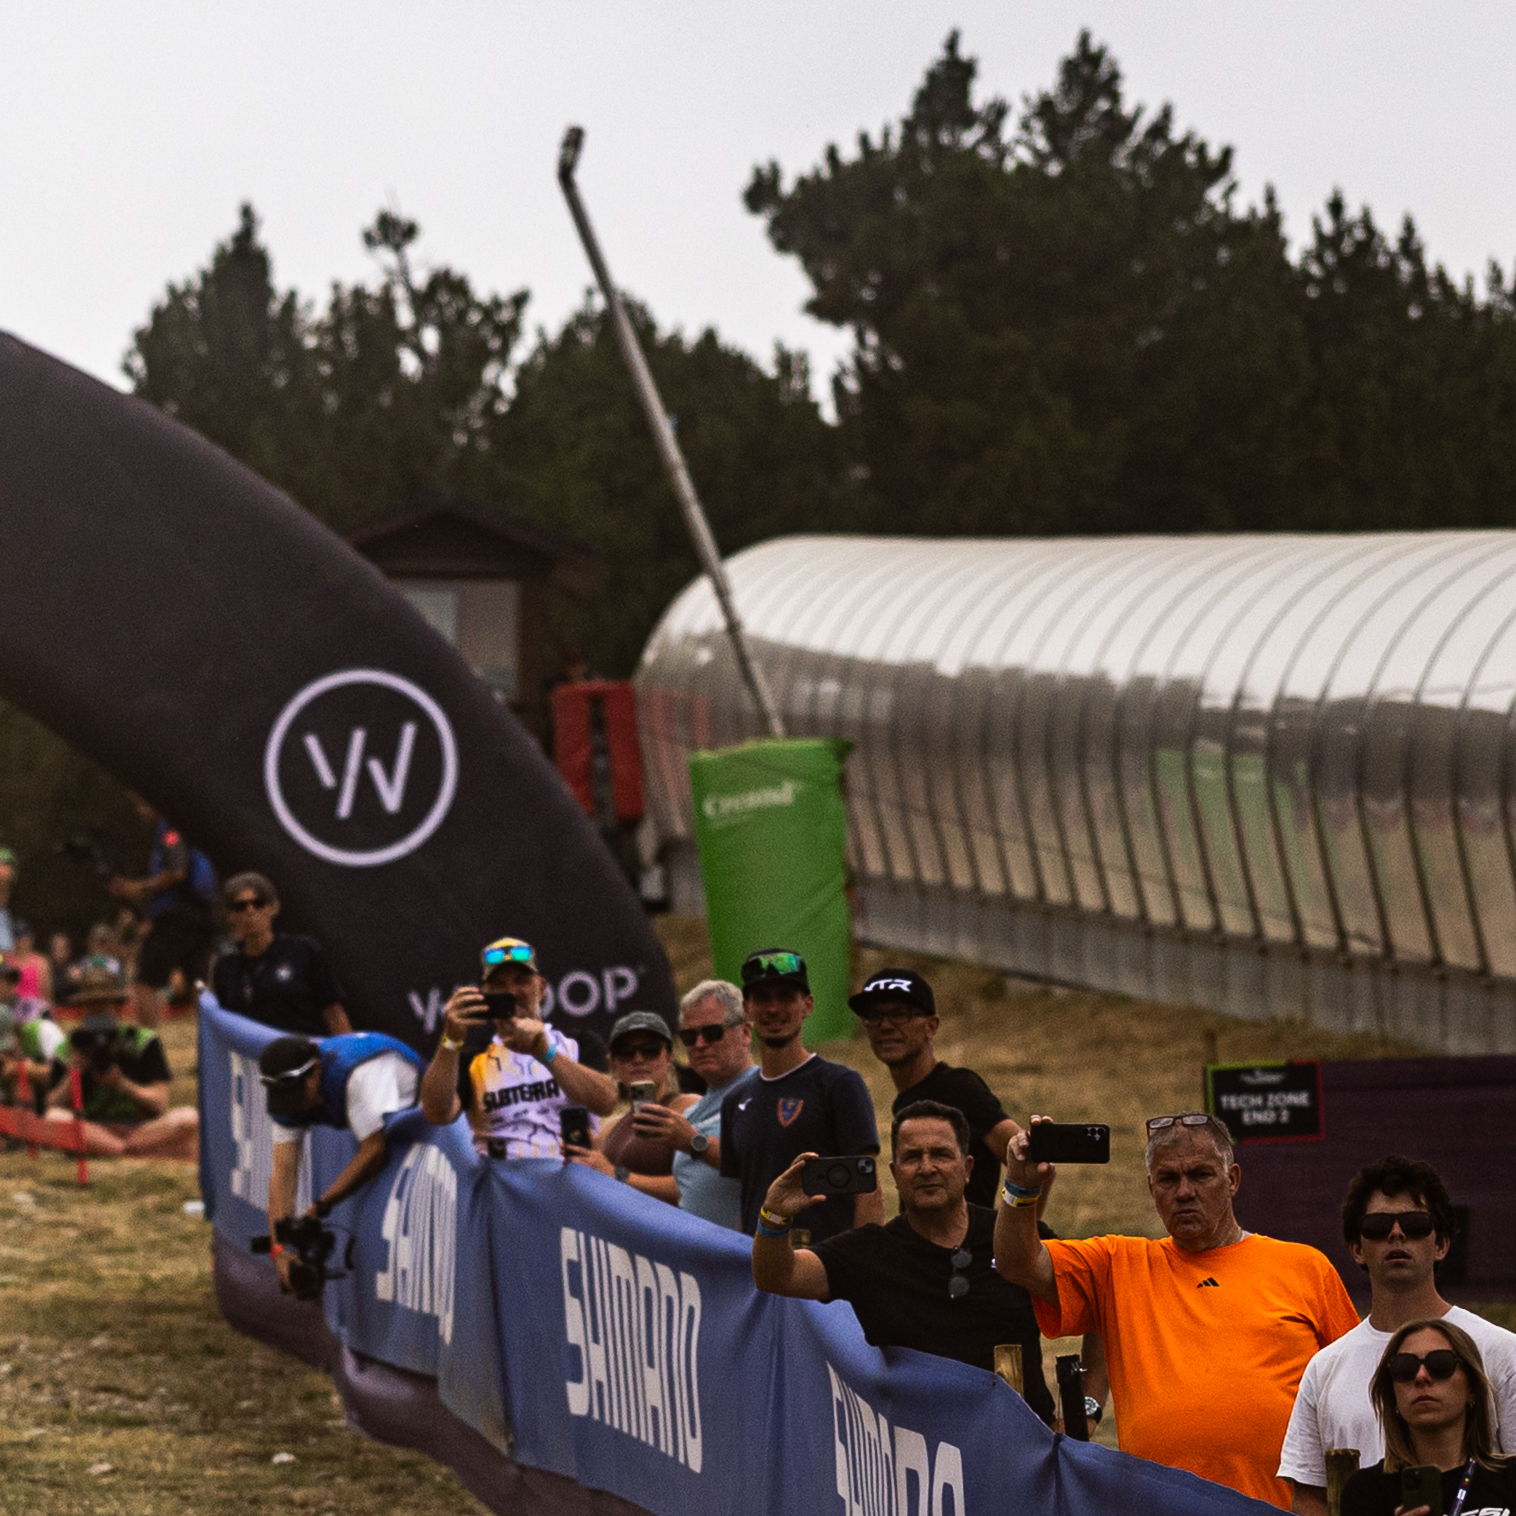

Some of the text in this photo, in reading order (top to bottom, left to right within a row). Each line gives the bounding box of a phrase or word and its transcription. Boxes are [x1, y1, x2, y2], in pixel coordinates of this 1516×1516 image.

[303, 721, 418, 819] W
[408, 966, 638, 1034] WOP
[1220, 1090, 1310, 1110] TECH ZONE
[560, 1227, 703, 1474] SHIMANO
